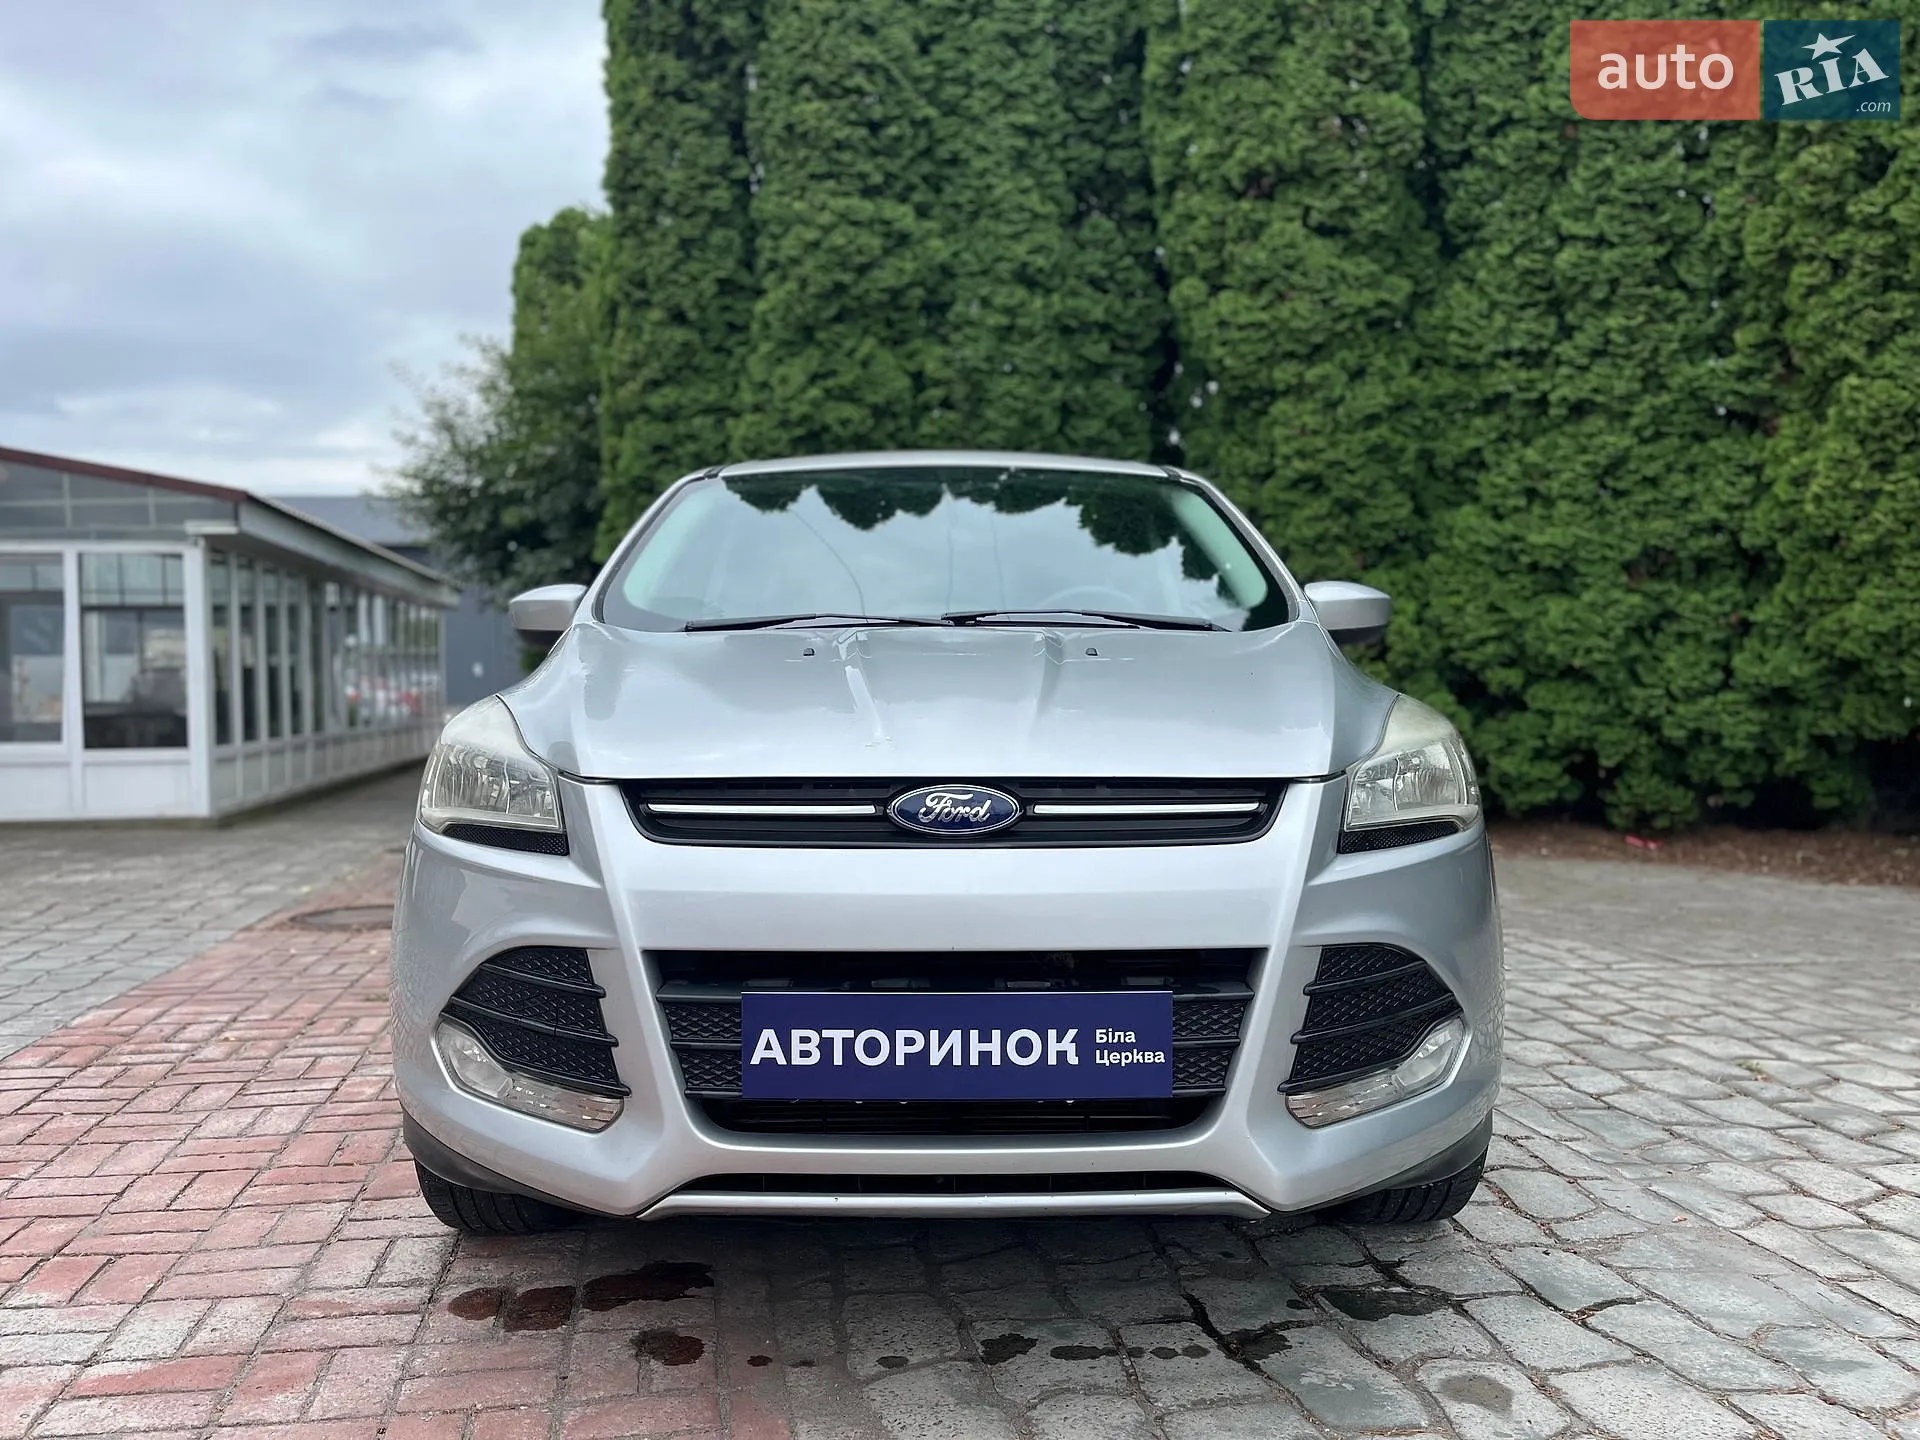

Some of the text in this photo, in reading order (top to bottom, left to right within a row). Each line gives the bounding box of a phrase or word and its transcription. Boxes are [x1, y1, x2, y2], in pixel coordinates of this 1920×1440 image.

[917, 792, 992, 823] Ford
[749, 1028, 1079, 1067] АВТОРИНОК
[1095, 1028, 1136, 1044] Біла
[1095, 1048, 1166, 1067] Церква
